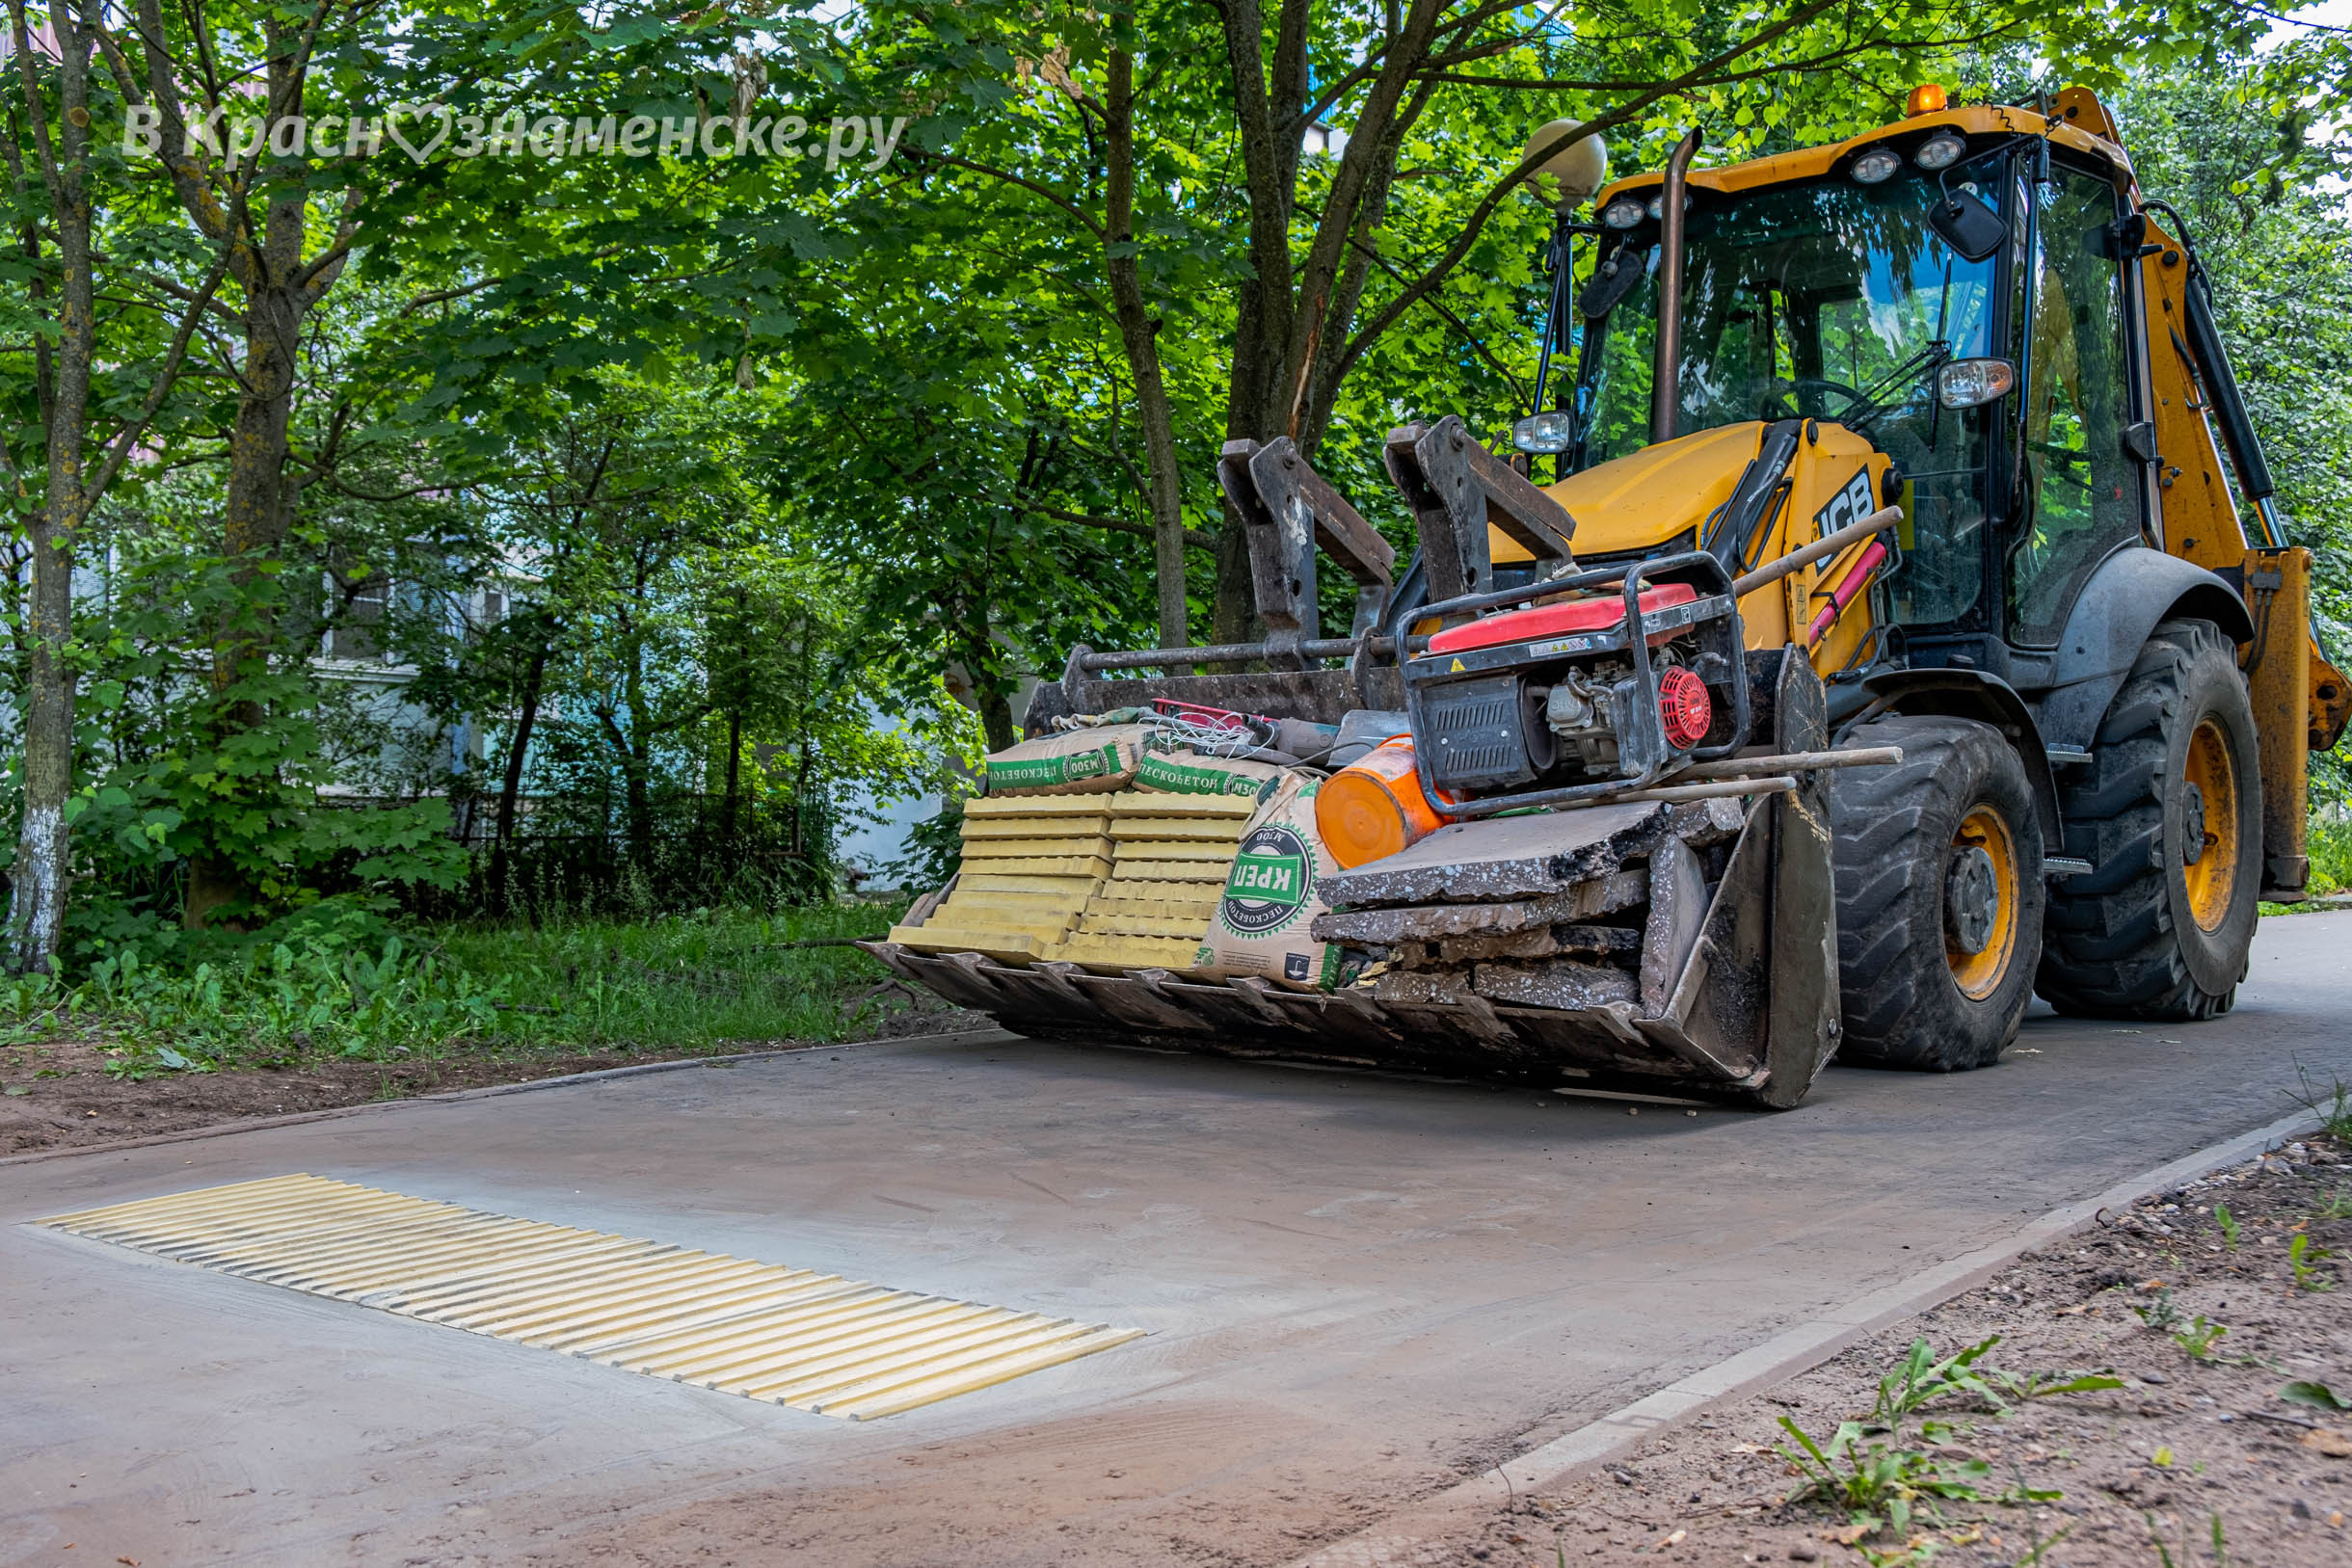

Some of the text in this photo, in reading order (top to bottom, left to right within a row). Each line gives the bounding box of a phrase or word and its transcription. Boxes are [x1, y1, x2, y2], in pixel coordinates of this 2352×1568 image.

[1816, 472, 1873, 568] JCB
[1070, 757, 1099, 773] М300
[1137, 763, 1218, 789] ПЕСКОБЕТОН
[1233, 864, 1292, 891] КРЕП
[1227, 900, 1284, 924] ПЕСКОБЕТОН
